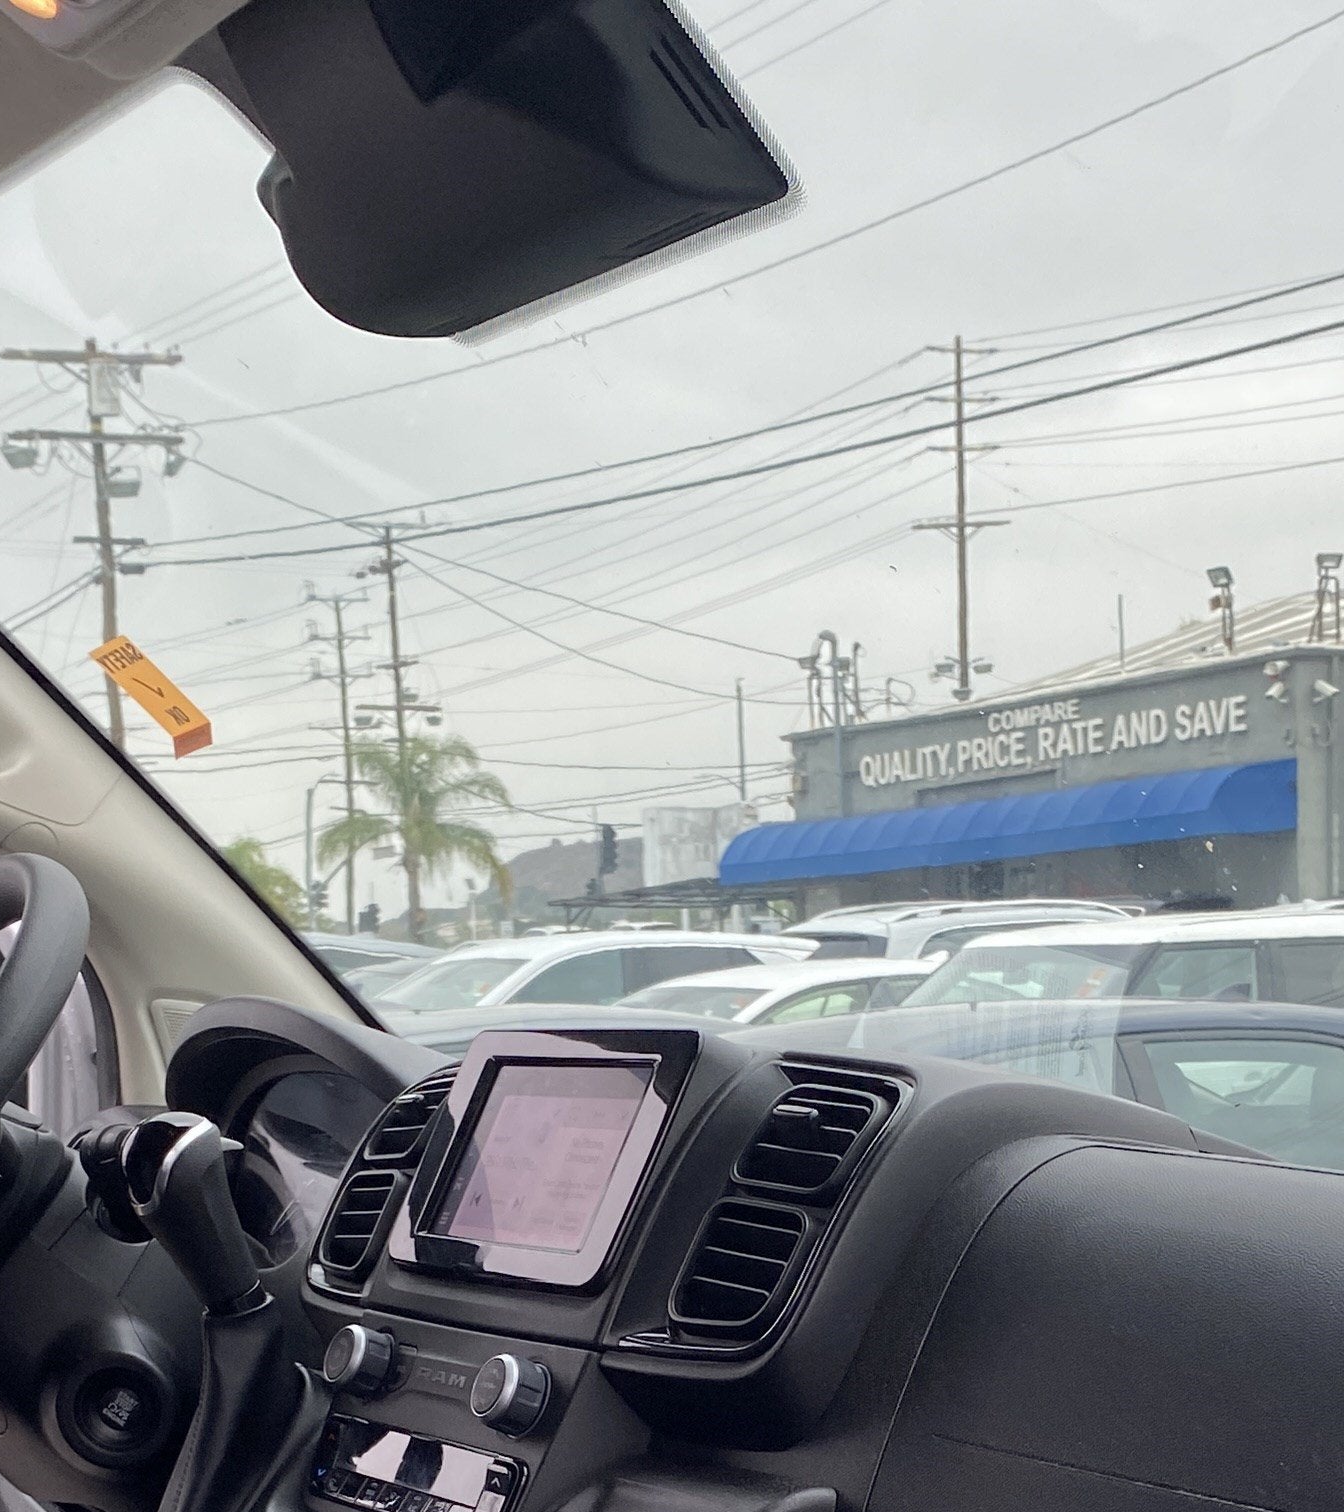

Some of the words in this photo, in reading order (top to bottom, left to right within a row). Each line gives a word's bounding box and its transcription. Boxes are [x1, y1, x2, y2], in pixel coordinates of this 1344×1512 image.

[988, 699, 1081, 733] COMPARE
[859, 743, 955, 788] QUALITY,
[957, 731, 1033, 774] PRICE,
[1037, 717, 1104, 762] RATE
[1110, 708, 1168, 752] AND
[1174, 695, 1248, 741] SAVE
[416, 1366, 467, 1389] RAM
